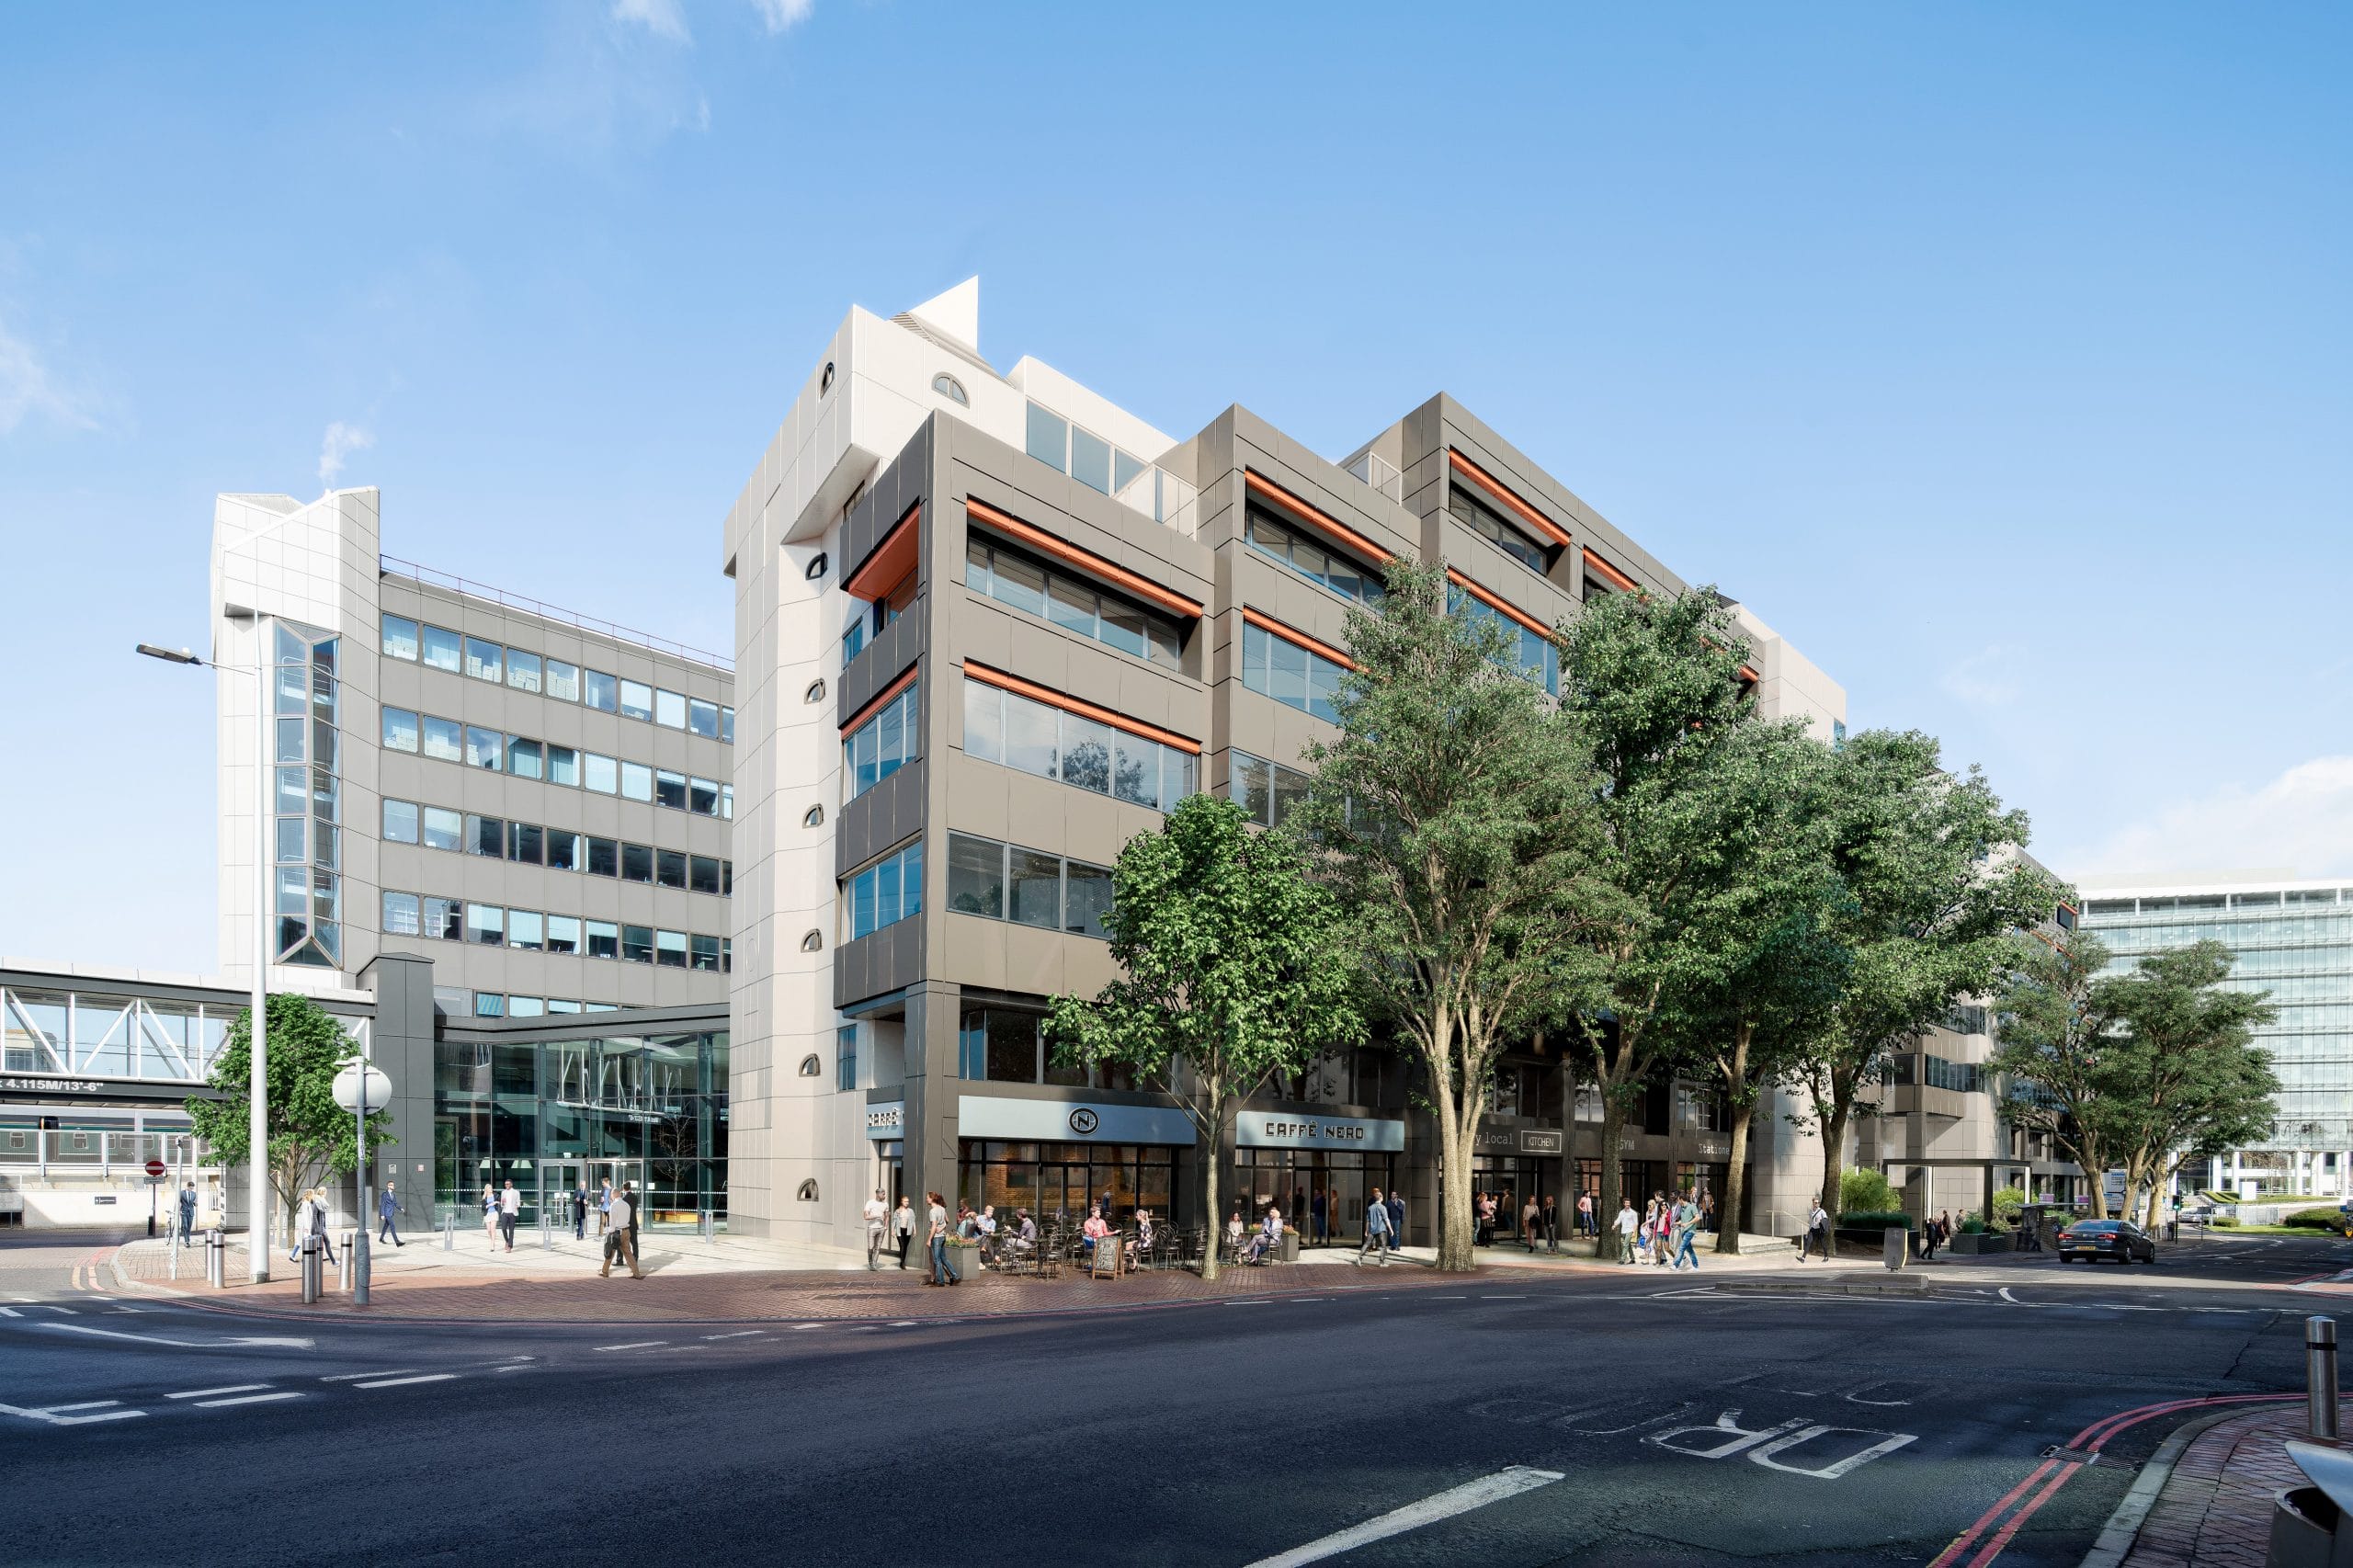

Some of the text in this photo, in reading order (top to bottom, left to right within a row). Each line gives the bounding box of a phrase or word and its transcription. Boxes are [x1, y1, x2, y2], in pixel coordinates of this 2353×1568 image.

[1324, 1126, 1365, 1141] NERO
[1484, 1131, 1514, 1145] local
[1528, 1136, 1554, 1147] KITCHEN
[1698, 1142, 1730, 1155] Statione
